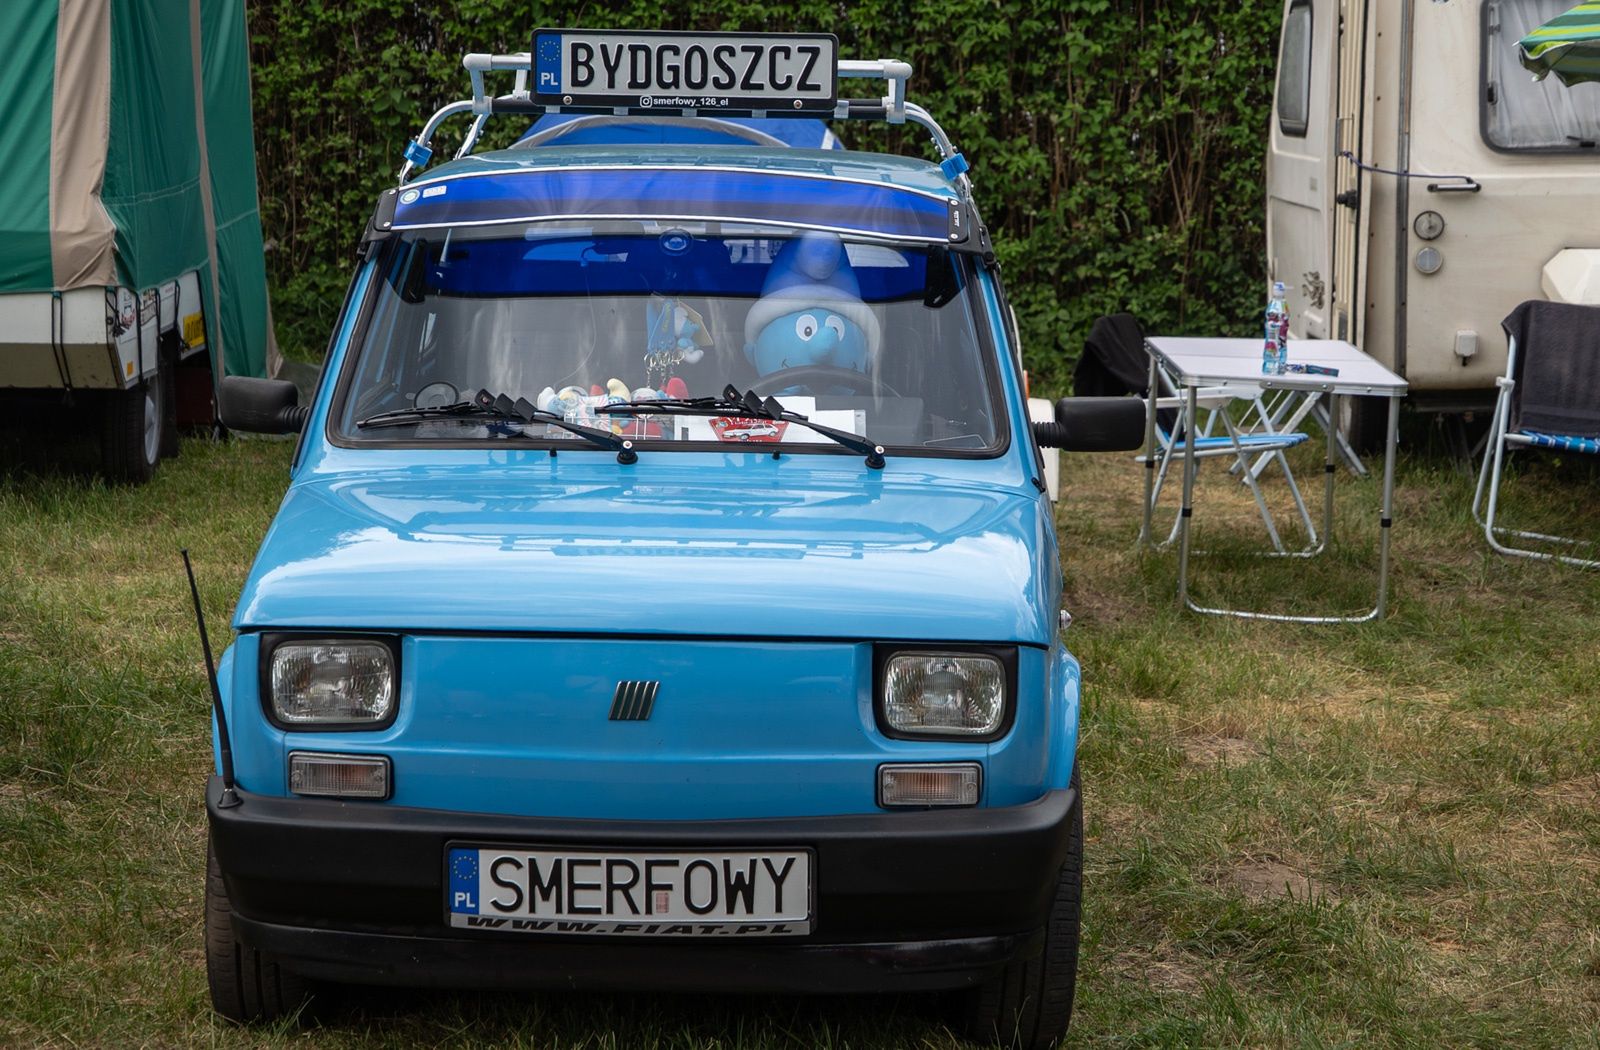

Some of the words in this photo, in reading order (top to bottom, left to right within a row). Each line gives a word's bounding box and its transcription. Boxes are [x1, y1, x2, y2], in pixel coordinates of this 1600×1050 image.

[570, 41, 821, 91] BYDGOSZCZ
[540, 72, 558, 86] PL
[653, 96, 729, 107] smerfowy_126_el
[490, 856, 796, 916] SMERFOWY
[454, 891, 476, 908] PL
[467, 916, 793, 935] WWW.FIAT.PL
